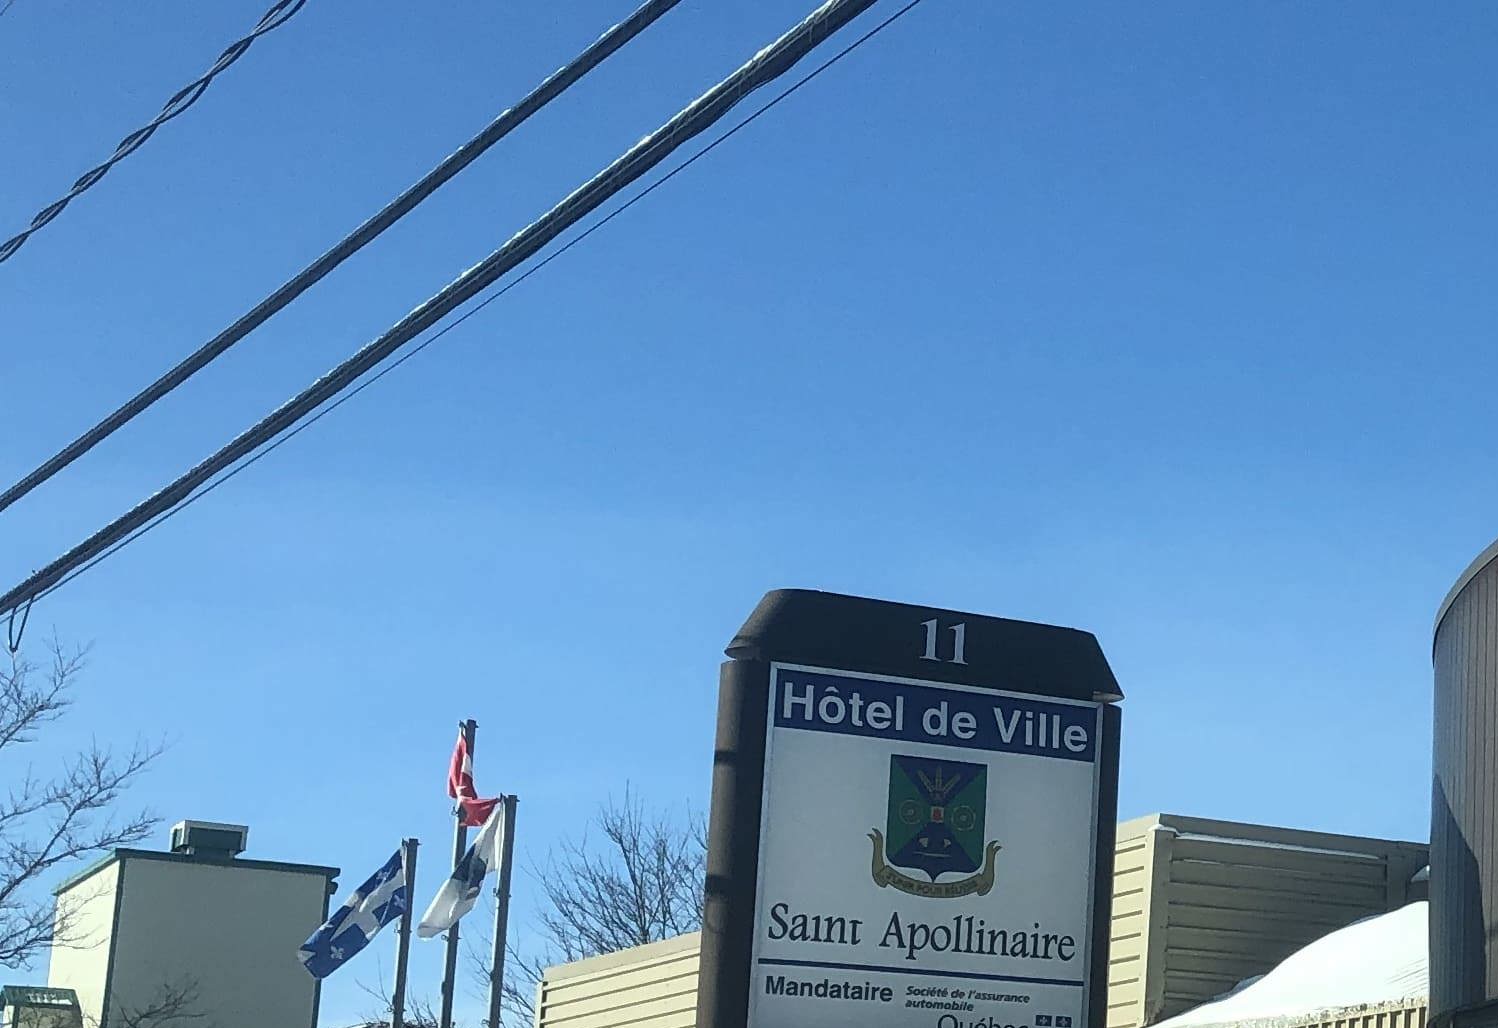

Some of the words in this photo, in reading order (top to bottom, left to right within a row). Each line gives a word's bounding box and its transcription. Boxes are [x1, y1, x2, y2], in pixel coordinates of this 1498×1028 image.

[920, 618, 969, 665] 11
[783, 682, 904, 731] Hôtel
[922, 701, 977, 739] de
[993, 707, 1088, 752] Ville
[768, 902, 863, 945] Saint
[879, 911, 1076, 961] Apollinaire
[765, 975, 893, 1002] Mandataire
[905, 985, 949, 998] Société
[951, 989, 965, 999] de
[967, 990, 1031, 1003] l'assurance
[905, 1000, 974, 1011] automobile
